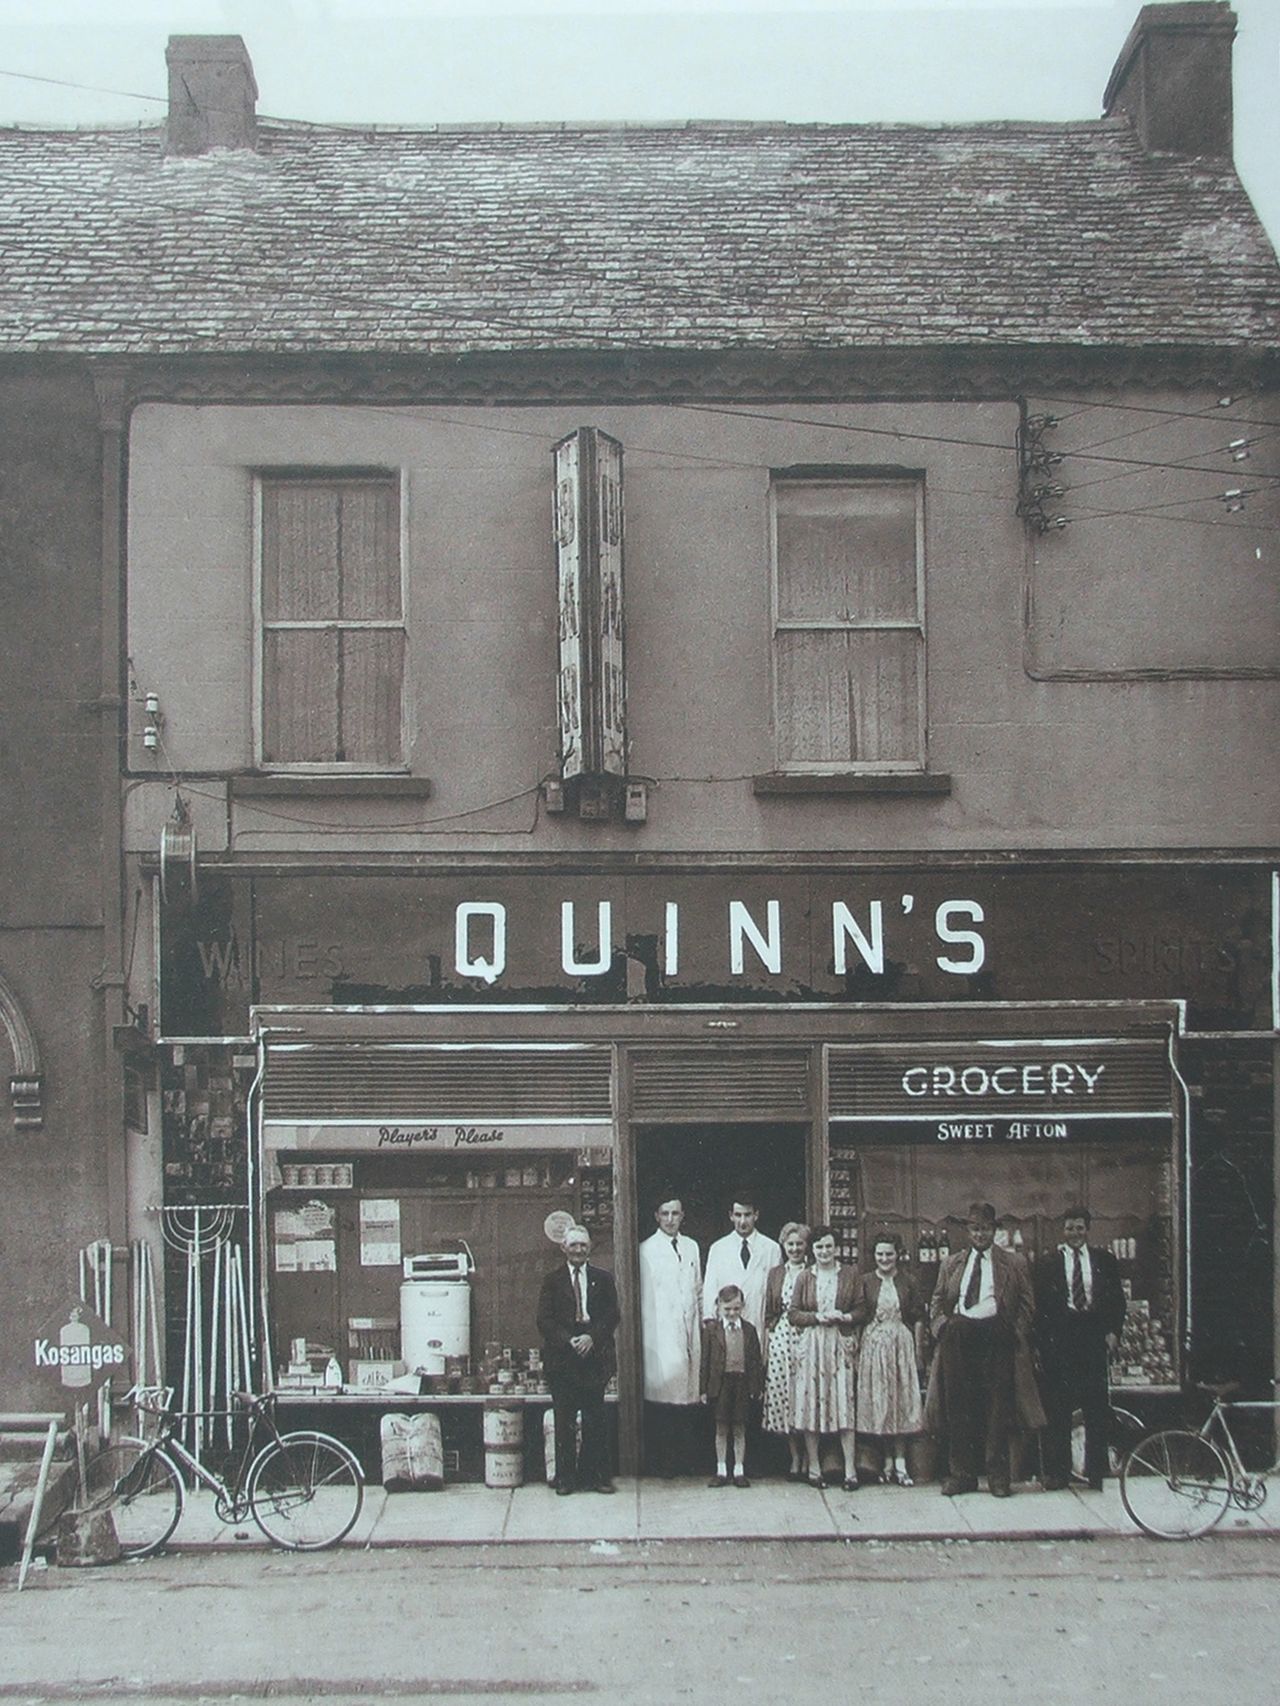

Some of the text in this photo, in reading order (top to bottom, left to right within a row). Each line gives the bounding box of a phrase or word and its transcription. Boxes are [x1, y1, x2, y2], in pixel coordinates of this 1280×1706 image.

[455, 894, 986, 984] QUINN'S
[197, 940, 345, 980] WINES
[901, 1062, 1105, 1096] GROCERY
[377, 1125, 504, 1147] Player's Please
[936, 1121, 1067, 1141] SWEET AFTON
[34, 1338, 124, 1370] Kosangas
